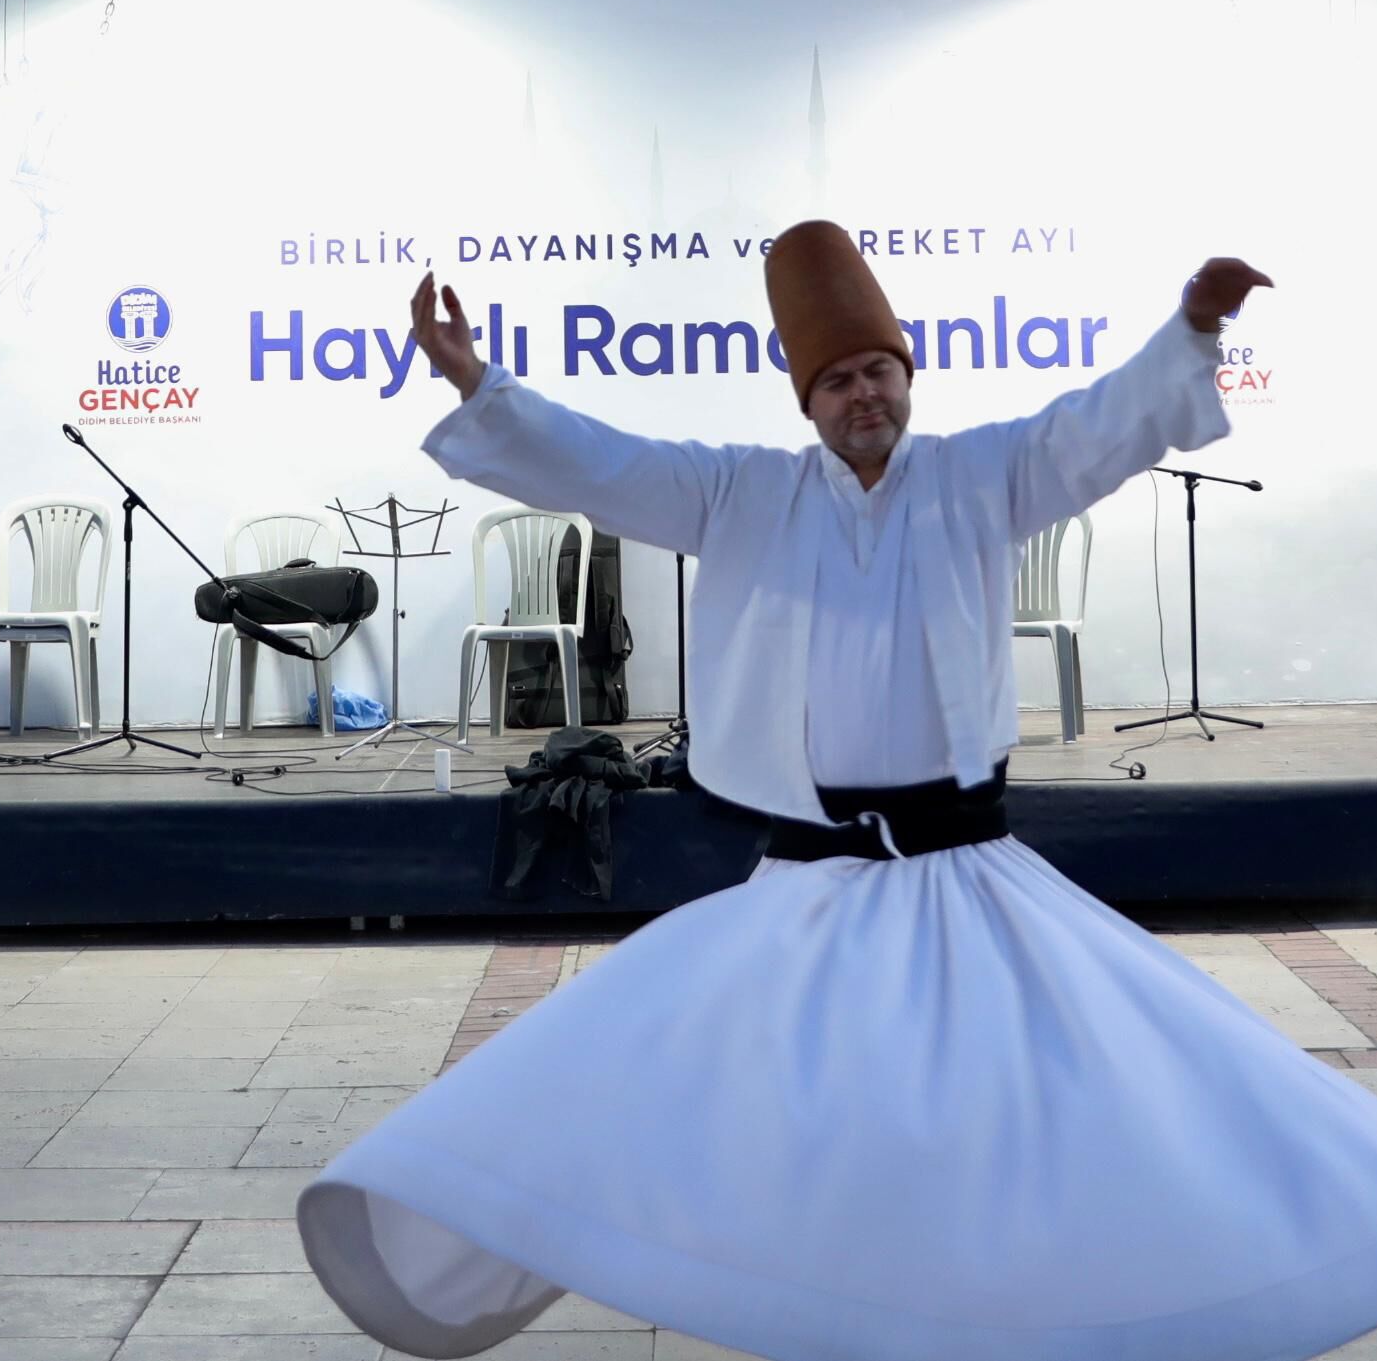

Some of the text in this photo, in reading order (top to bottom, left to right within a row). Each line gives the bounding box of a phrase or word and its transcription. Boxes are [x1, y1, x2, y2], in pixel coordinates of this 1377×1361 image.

[280, 227, 1075, 268] BİRLİK, DAYANIŞMA ve REKET AYI
[249, 295, 1108, 399] Haylı Ramanlar
[1217, 340, 1254, 366] ice
[97, 359, 181, 386] Hatice
[1215, 370, 1273, 395] ÇAY
[78, 387, 200, 414] GENÇAY
[78, 417, 106, 426] DİDİM
[109, 415, 156, 425] BELEDİYE
